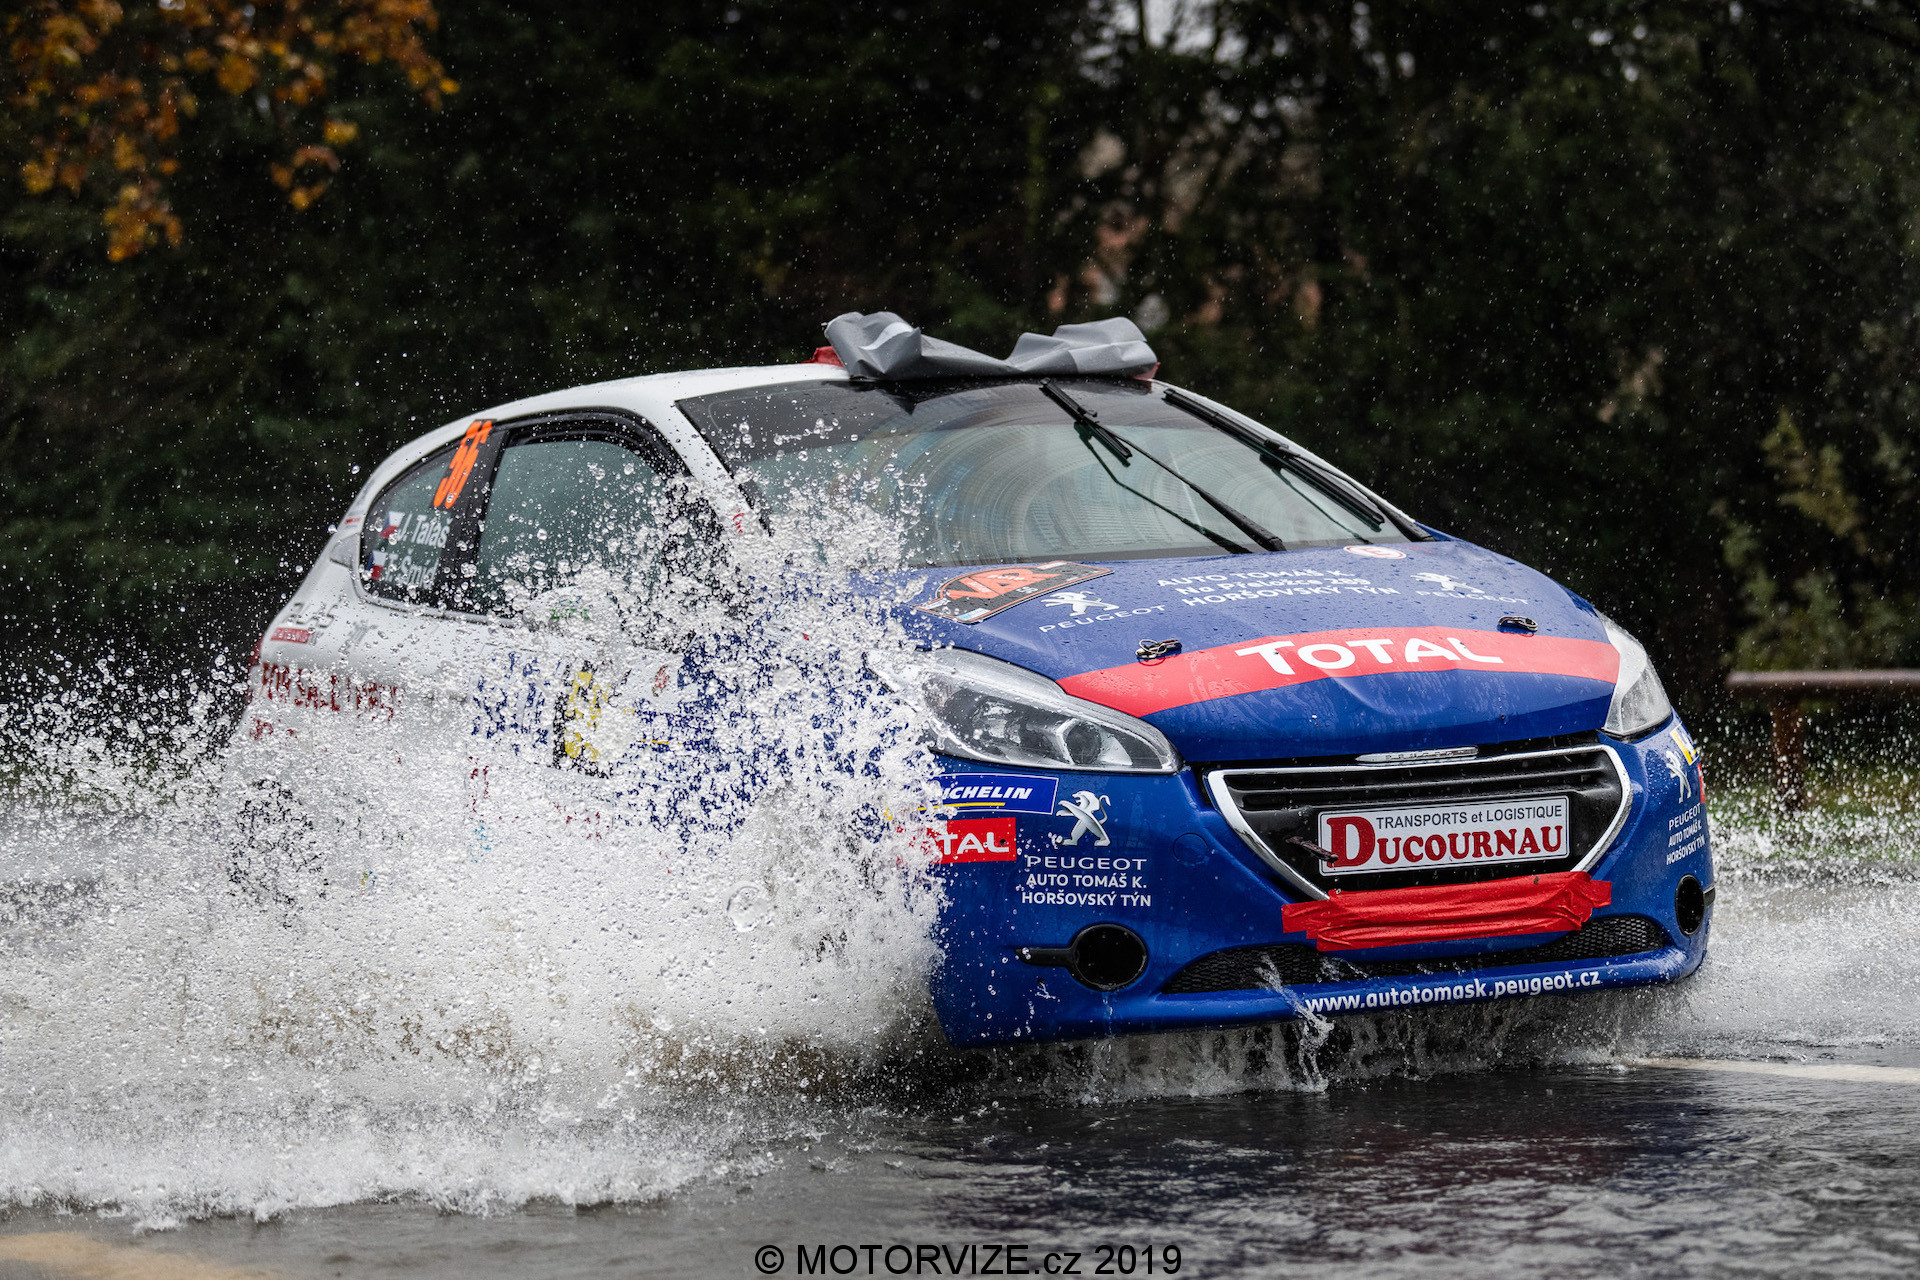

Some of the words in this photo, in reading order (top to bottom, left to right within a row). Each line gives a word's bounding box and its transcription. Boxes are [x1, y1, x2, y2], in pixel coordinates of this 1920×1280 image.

[1157, 574, 1228, 587] AUTO
[1229, 569, 1325, 580] TOMÁŠ
[1175, 586, 1215, 595] Na
[1181, 585, 1342, 606] HORŠOVSKÝ
[1343, 585, 1402, 595] TÝN
[1039, 604, 1166, 633] PEUGEOT
[1235, 637, 1504, 676] TOTAL
[940, 786, 1033, 800] ICHELIN
[1376, 811, 1468, 829] TRANSPORTS
[1471, 811, 1483, 823] et
[1486, 804, 1562, 822] LOGISTIQUE
[1668, 802, 1701, 831] PEUGEOT
[938, 831, 1010, 856] TAL
[1668, 831, 1683, 848] AUTO
[1666, 838, 1697, 866] HORŠOVSKÝ
[1026, 855, 1148, 871] PEUGEOT
[1026, 873, 1069, 887] AUTO
[1072, 872, 1127, 888] TOMÁŠ
[1131, 875, 1147, 889] K.
[1021, 889, 1117, 906] HORŠOVSKÝ
[1120, 891, 1152, 907] TÝN
[1305, 969, 1602, 1013] www.autotomask.peugeot.cz
